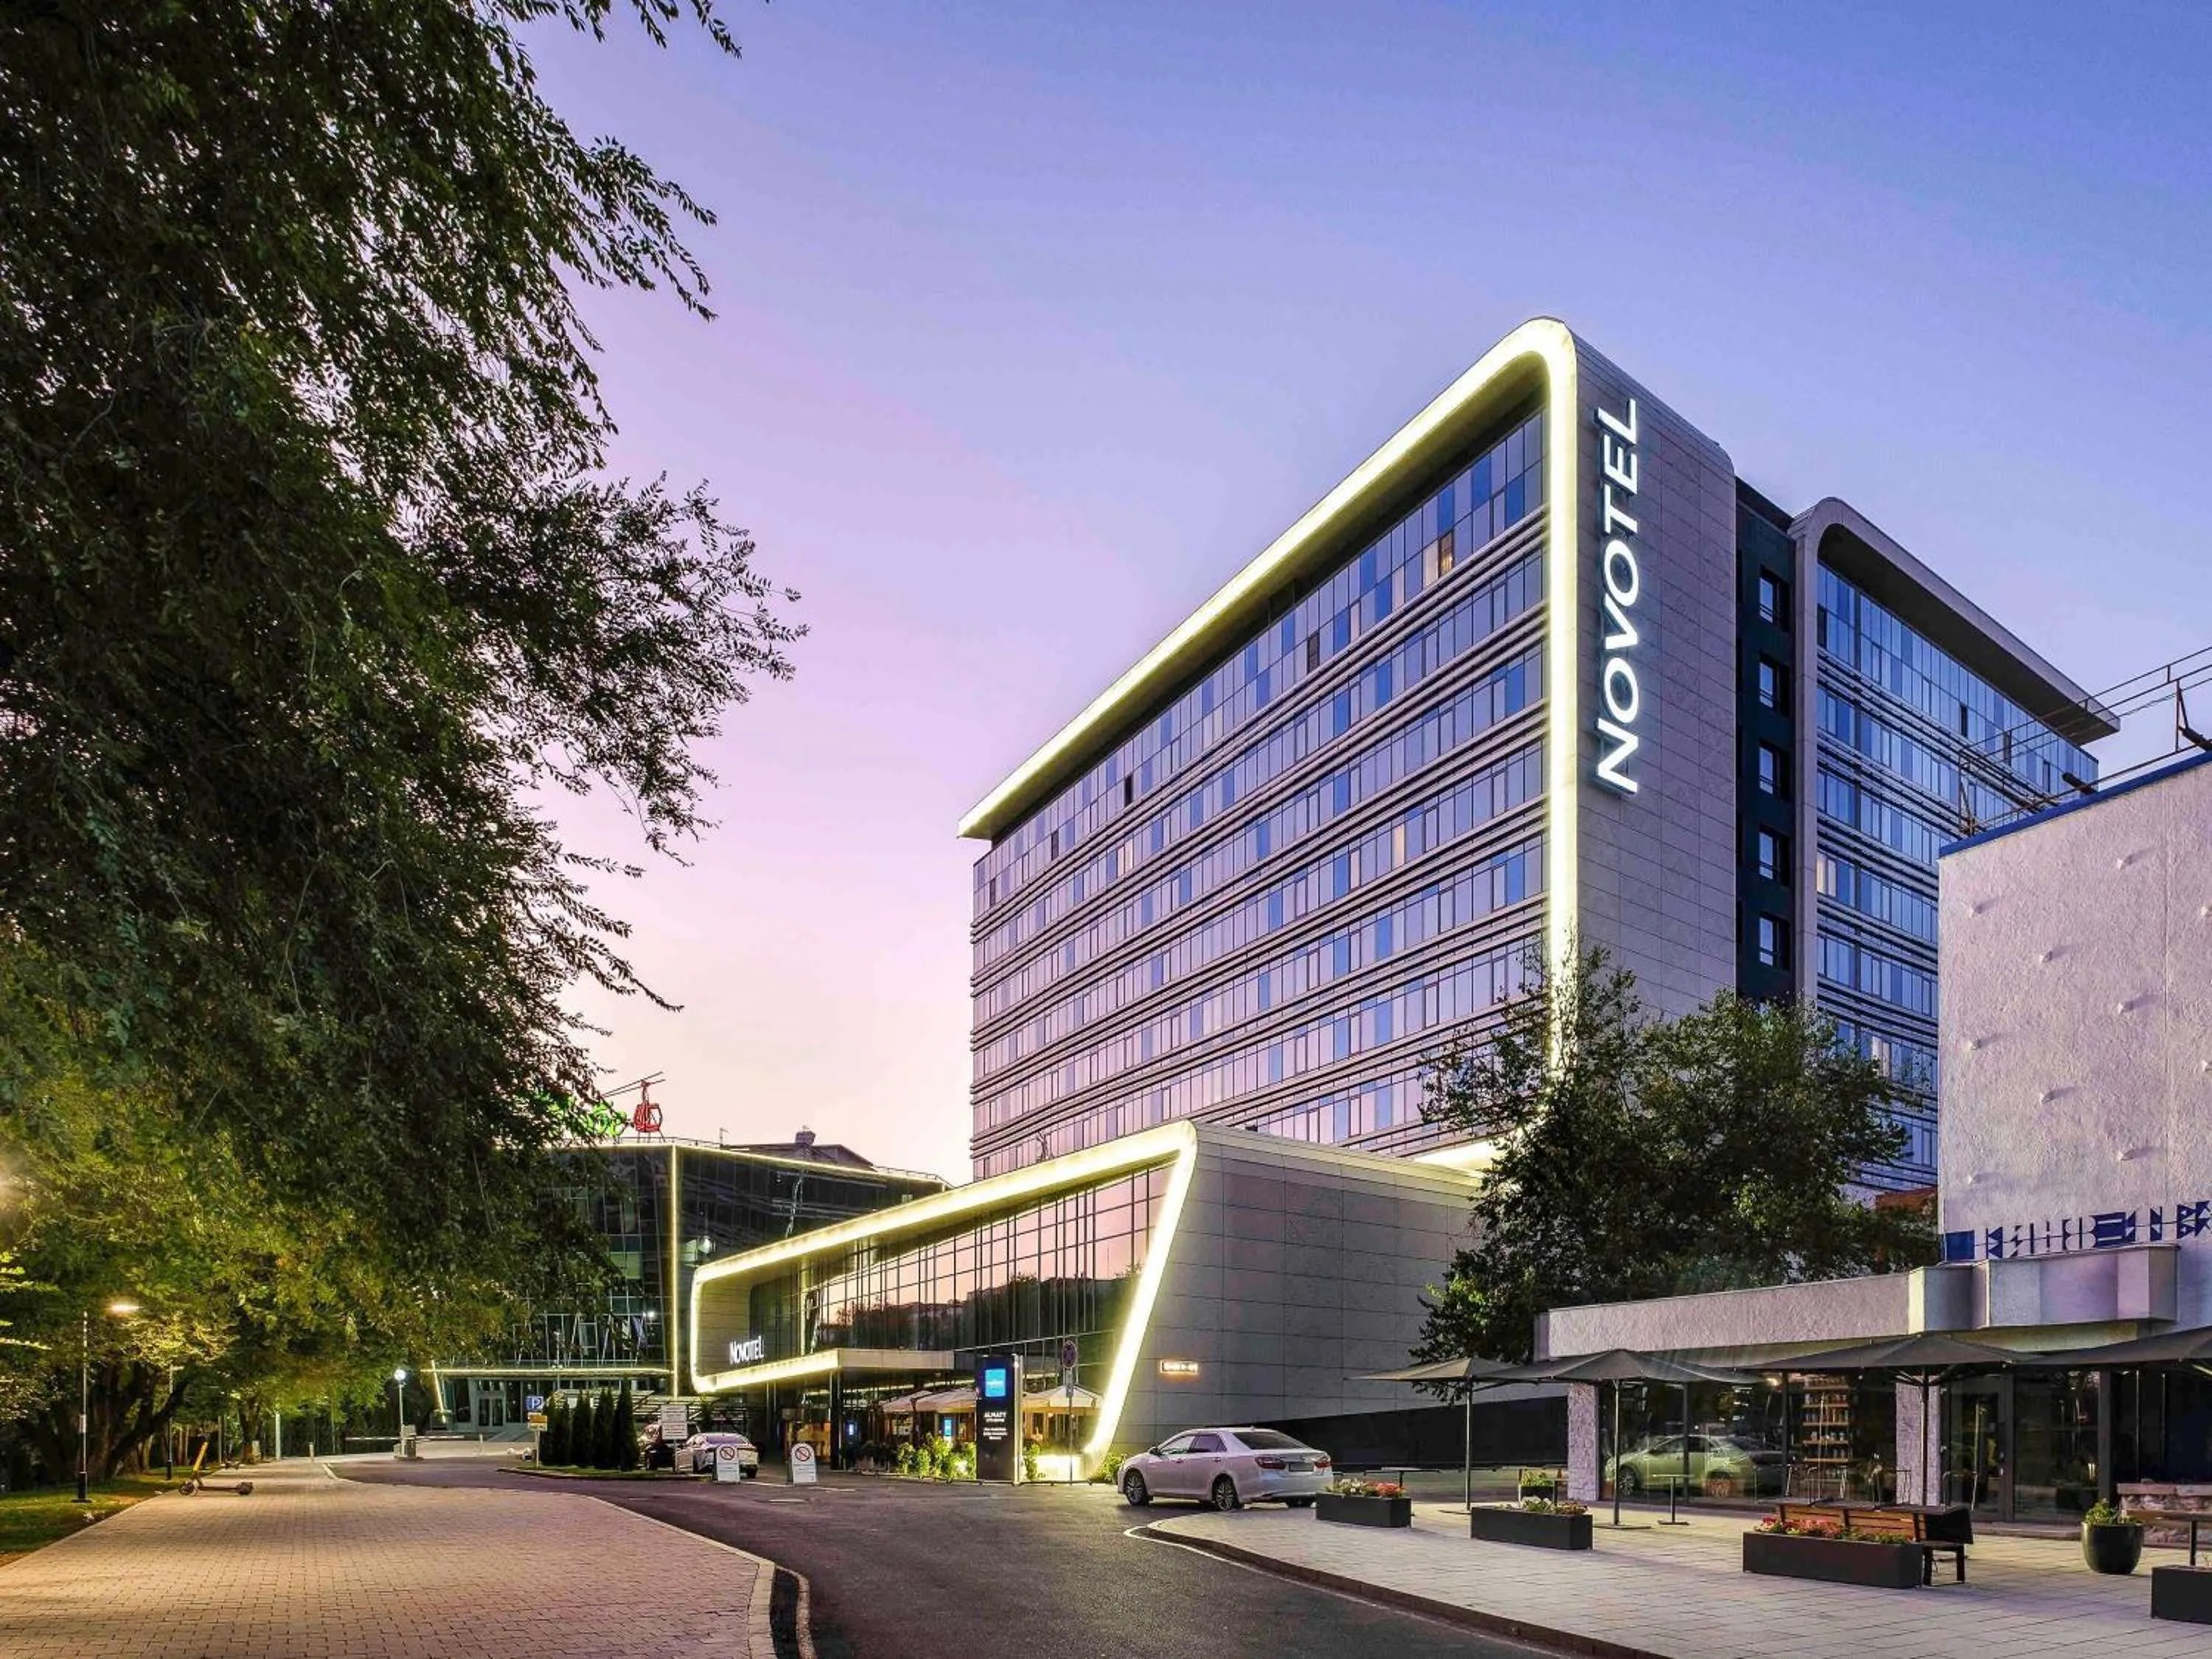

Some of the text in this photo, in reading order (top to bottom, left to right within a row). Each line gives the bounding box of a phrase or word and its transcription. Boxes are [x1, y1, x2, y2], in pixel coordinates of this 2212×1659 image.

[1596, 399, 1639, 793] NOVOTEL
[729, 1335, 765, 1365] NOVOTEL
[532, 1398, 540, 1409] P
